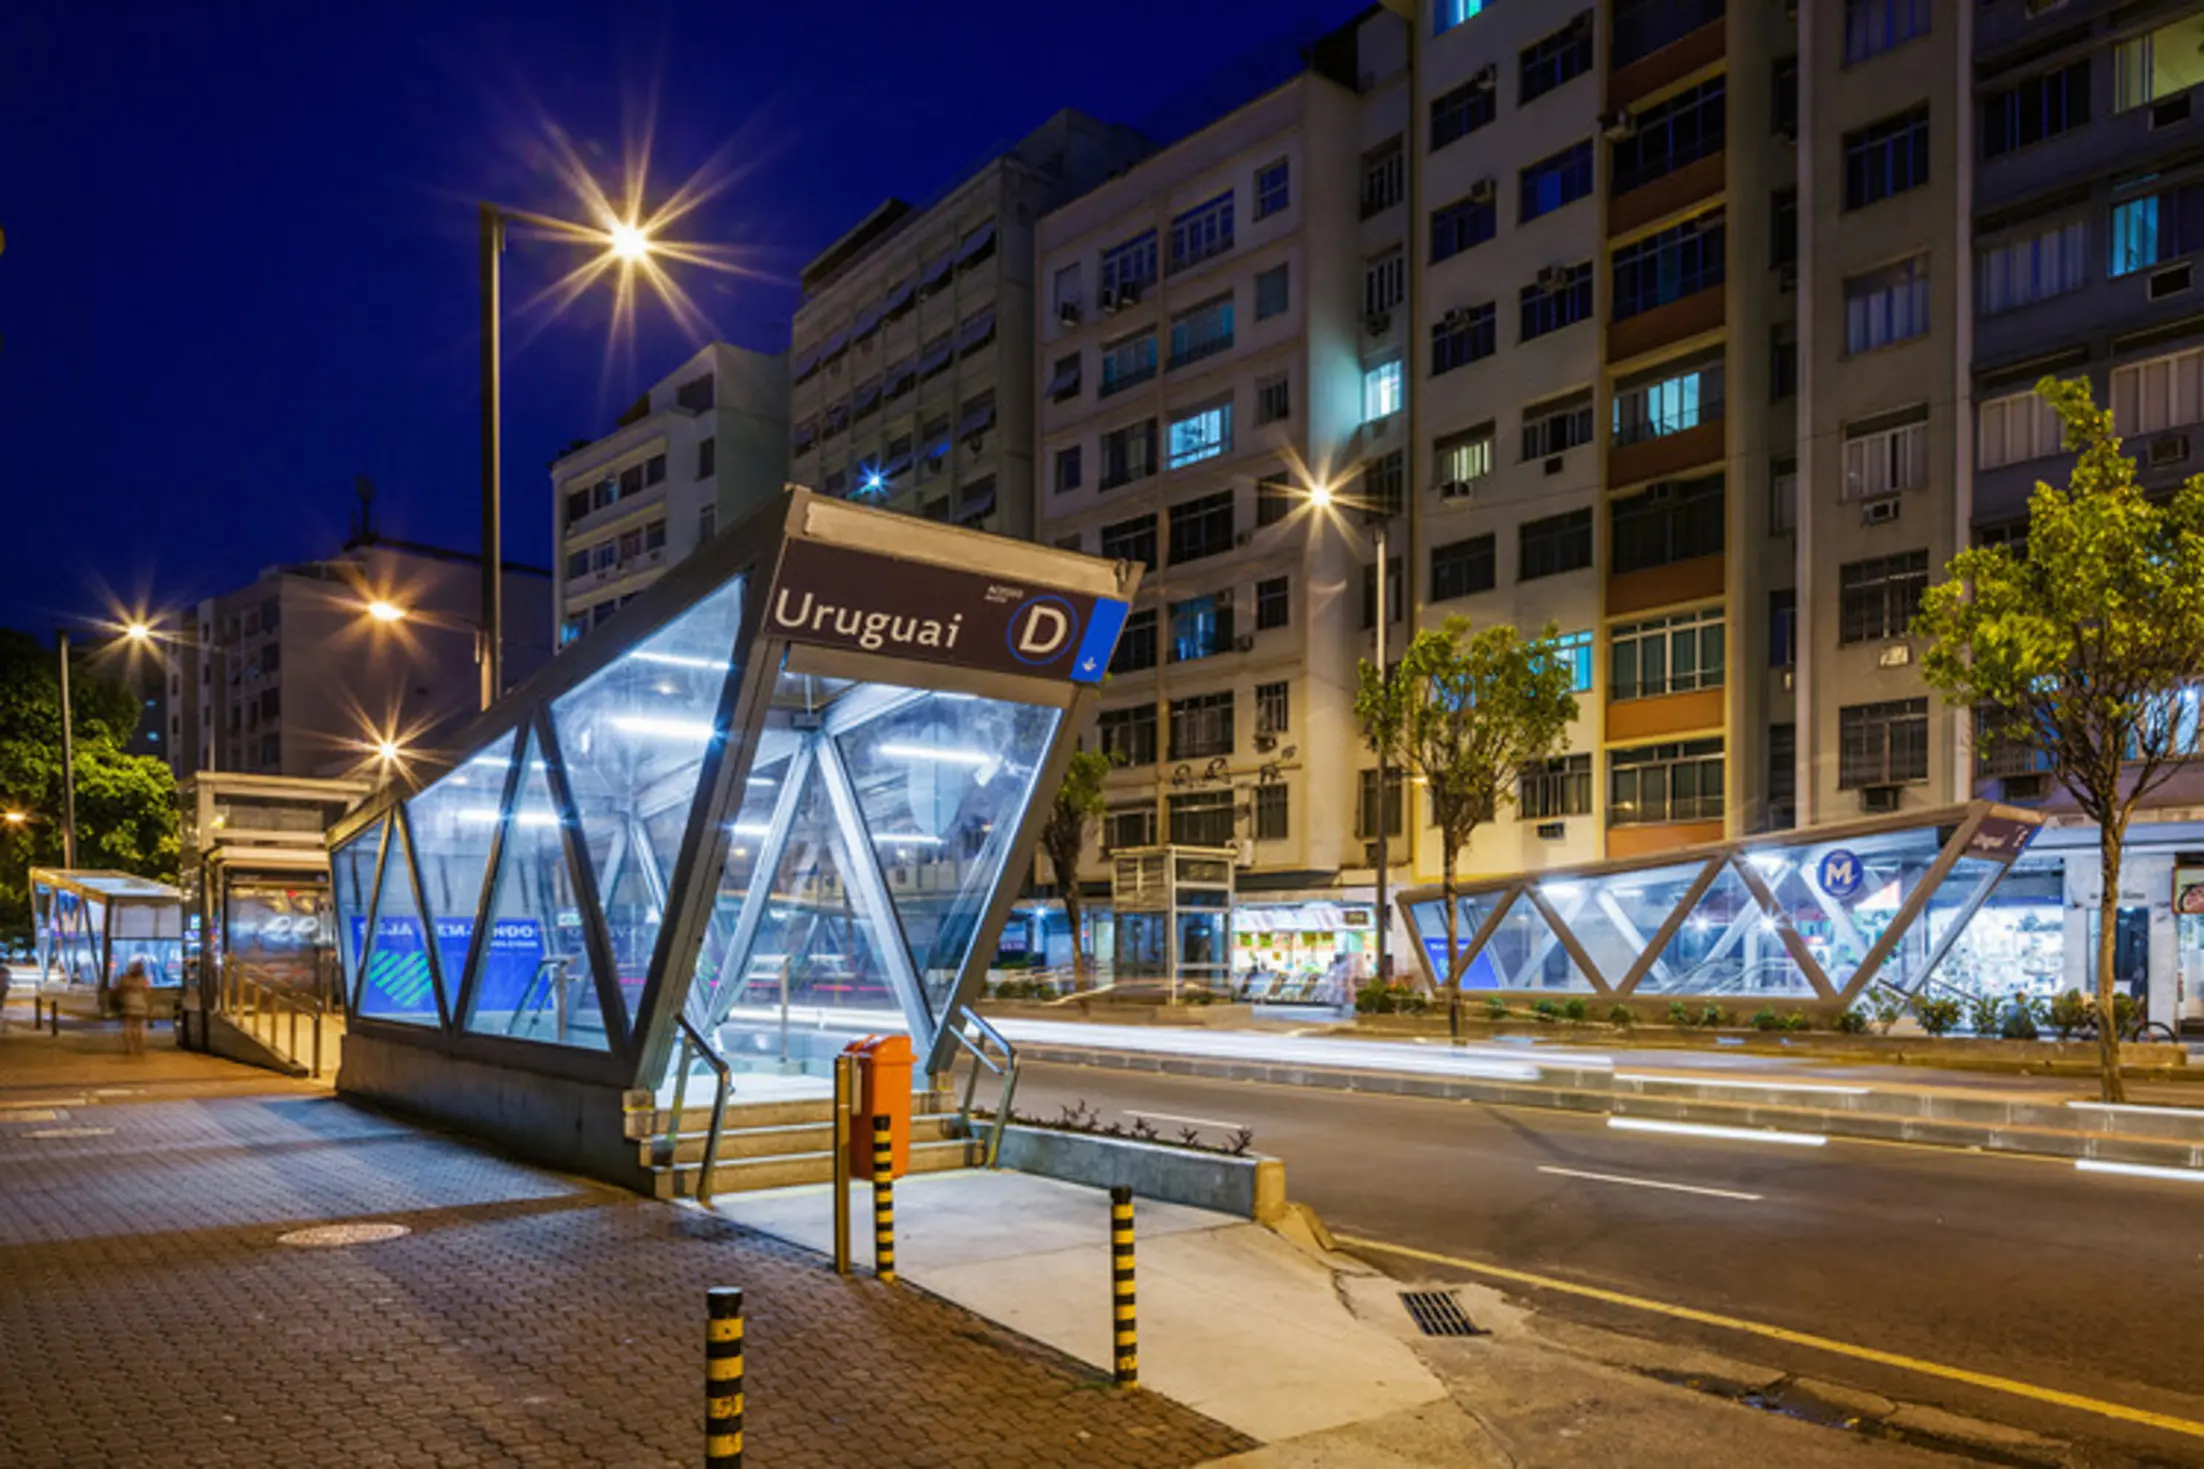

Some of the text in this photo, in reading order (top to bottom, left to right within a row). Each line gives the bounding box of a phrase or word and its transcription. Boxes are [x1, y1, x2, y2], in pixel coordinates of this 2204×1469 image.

[775, 588, 963, 650] Uruguai
[1018, 604, 1068, 654] D
[1825, 860, 1853, 887] M
